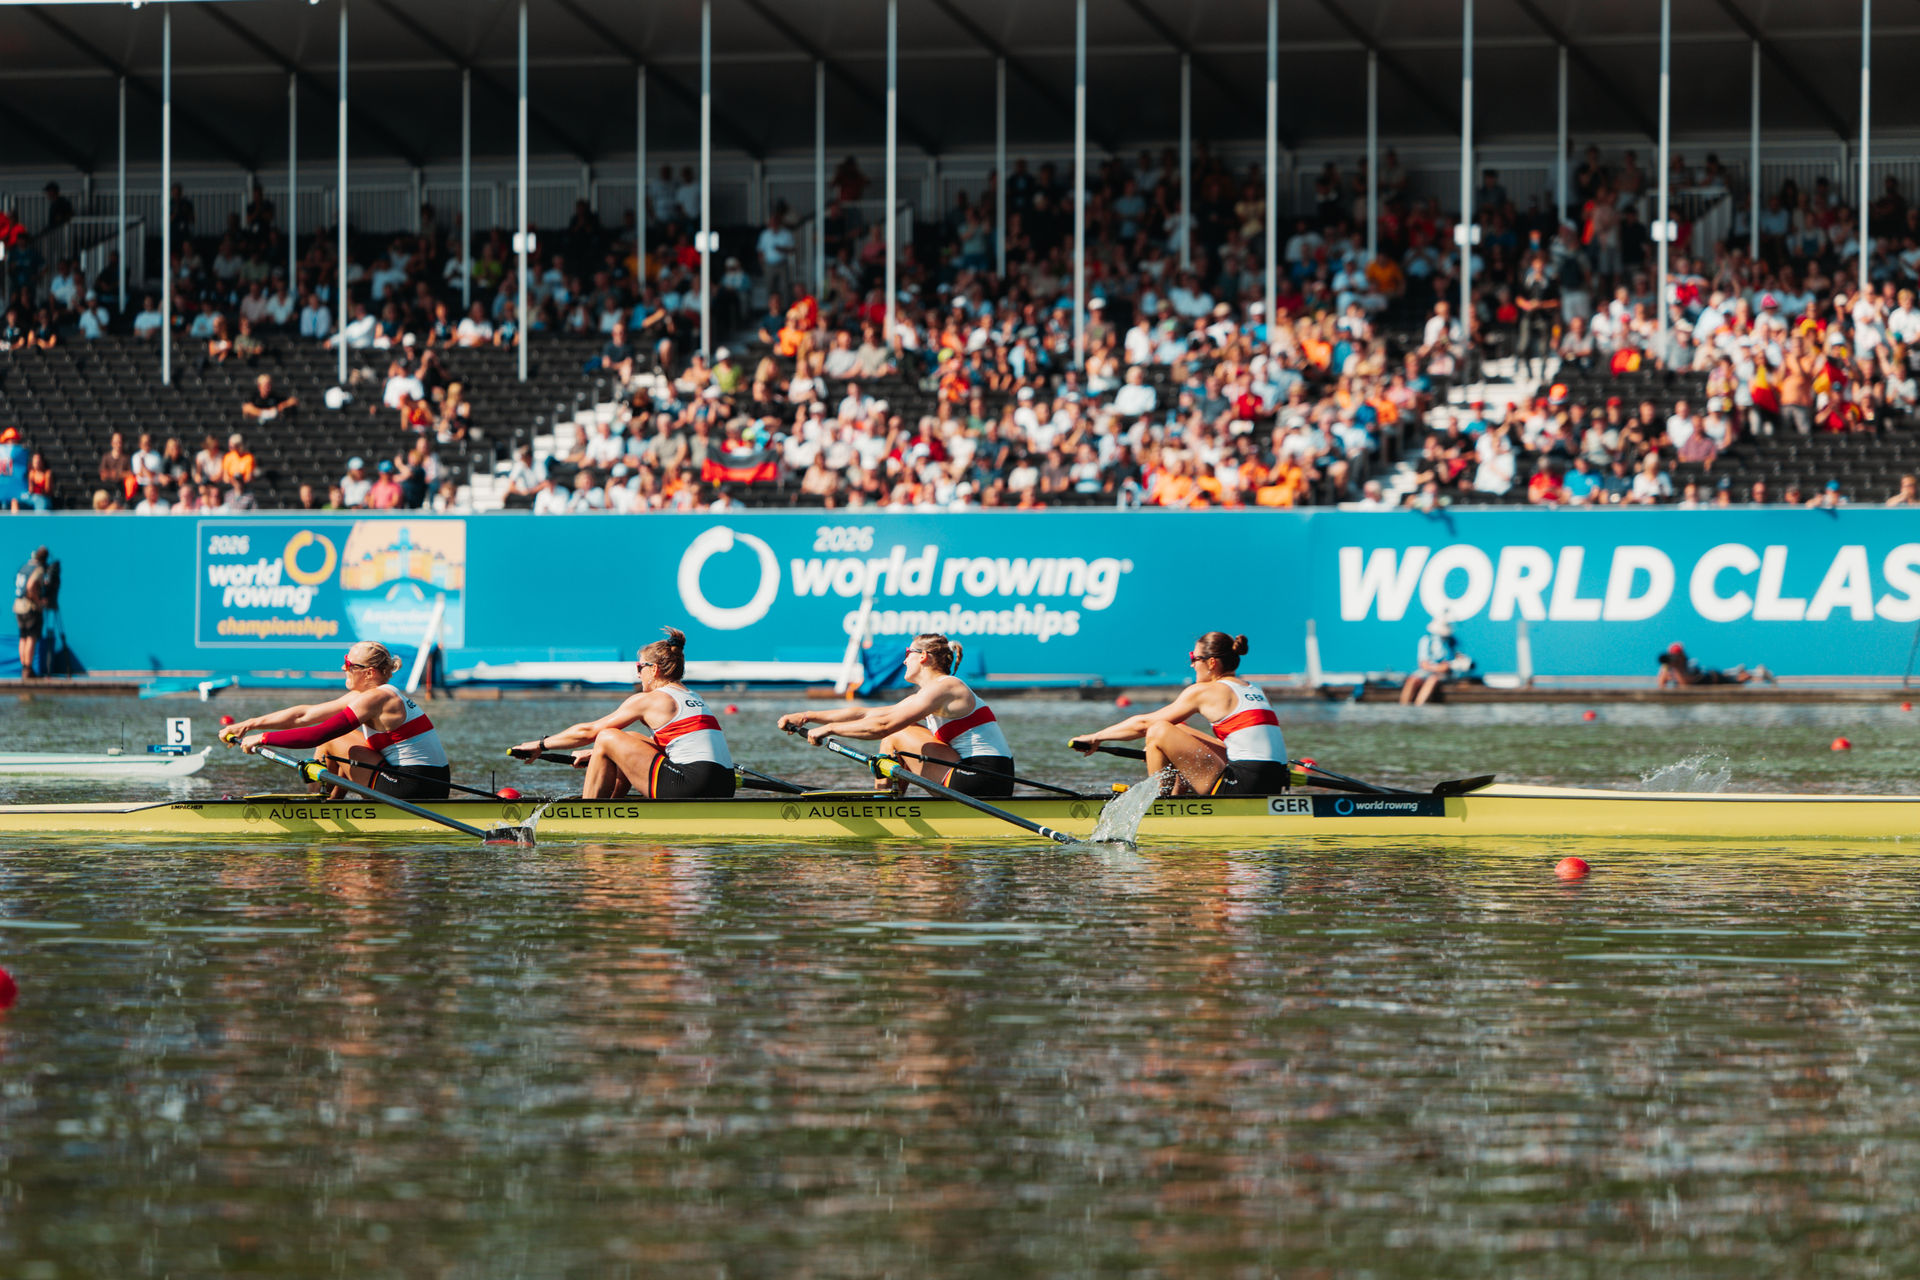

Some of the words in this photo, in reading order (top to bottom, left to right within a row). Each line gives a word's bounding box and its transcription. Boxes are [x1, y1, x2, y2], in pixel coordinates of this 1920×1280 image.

[208, 535, 250, 555] 2026
[813, 526, 875, 552] 2026
[208, 557, 283, 587] world
[790, 545, 939, 597] world
[940, 556, 1122, 610] rowing
[1338, 544, 1676, 621] WORLD
[1690, 542, 1920, 622] CLAS
[222, 584, 313, 615] rowing
[217, 616, 338, 639] championships
[175, 720, 185, 743] 5
[269, 807, 377, 820] AUGLETICS
[808, 806, 922, 818] AUGLETICS
[1272, 799, 1309, 812] GER
[1356, 801, 1383, 810] world
[1384, 801, 1418, 812] rowing
